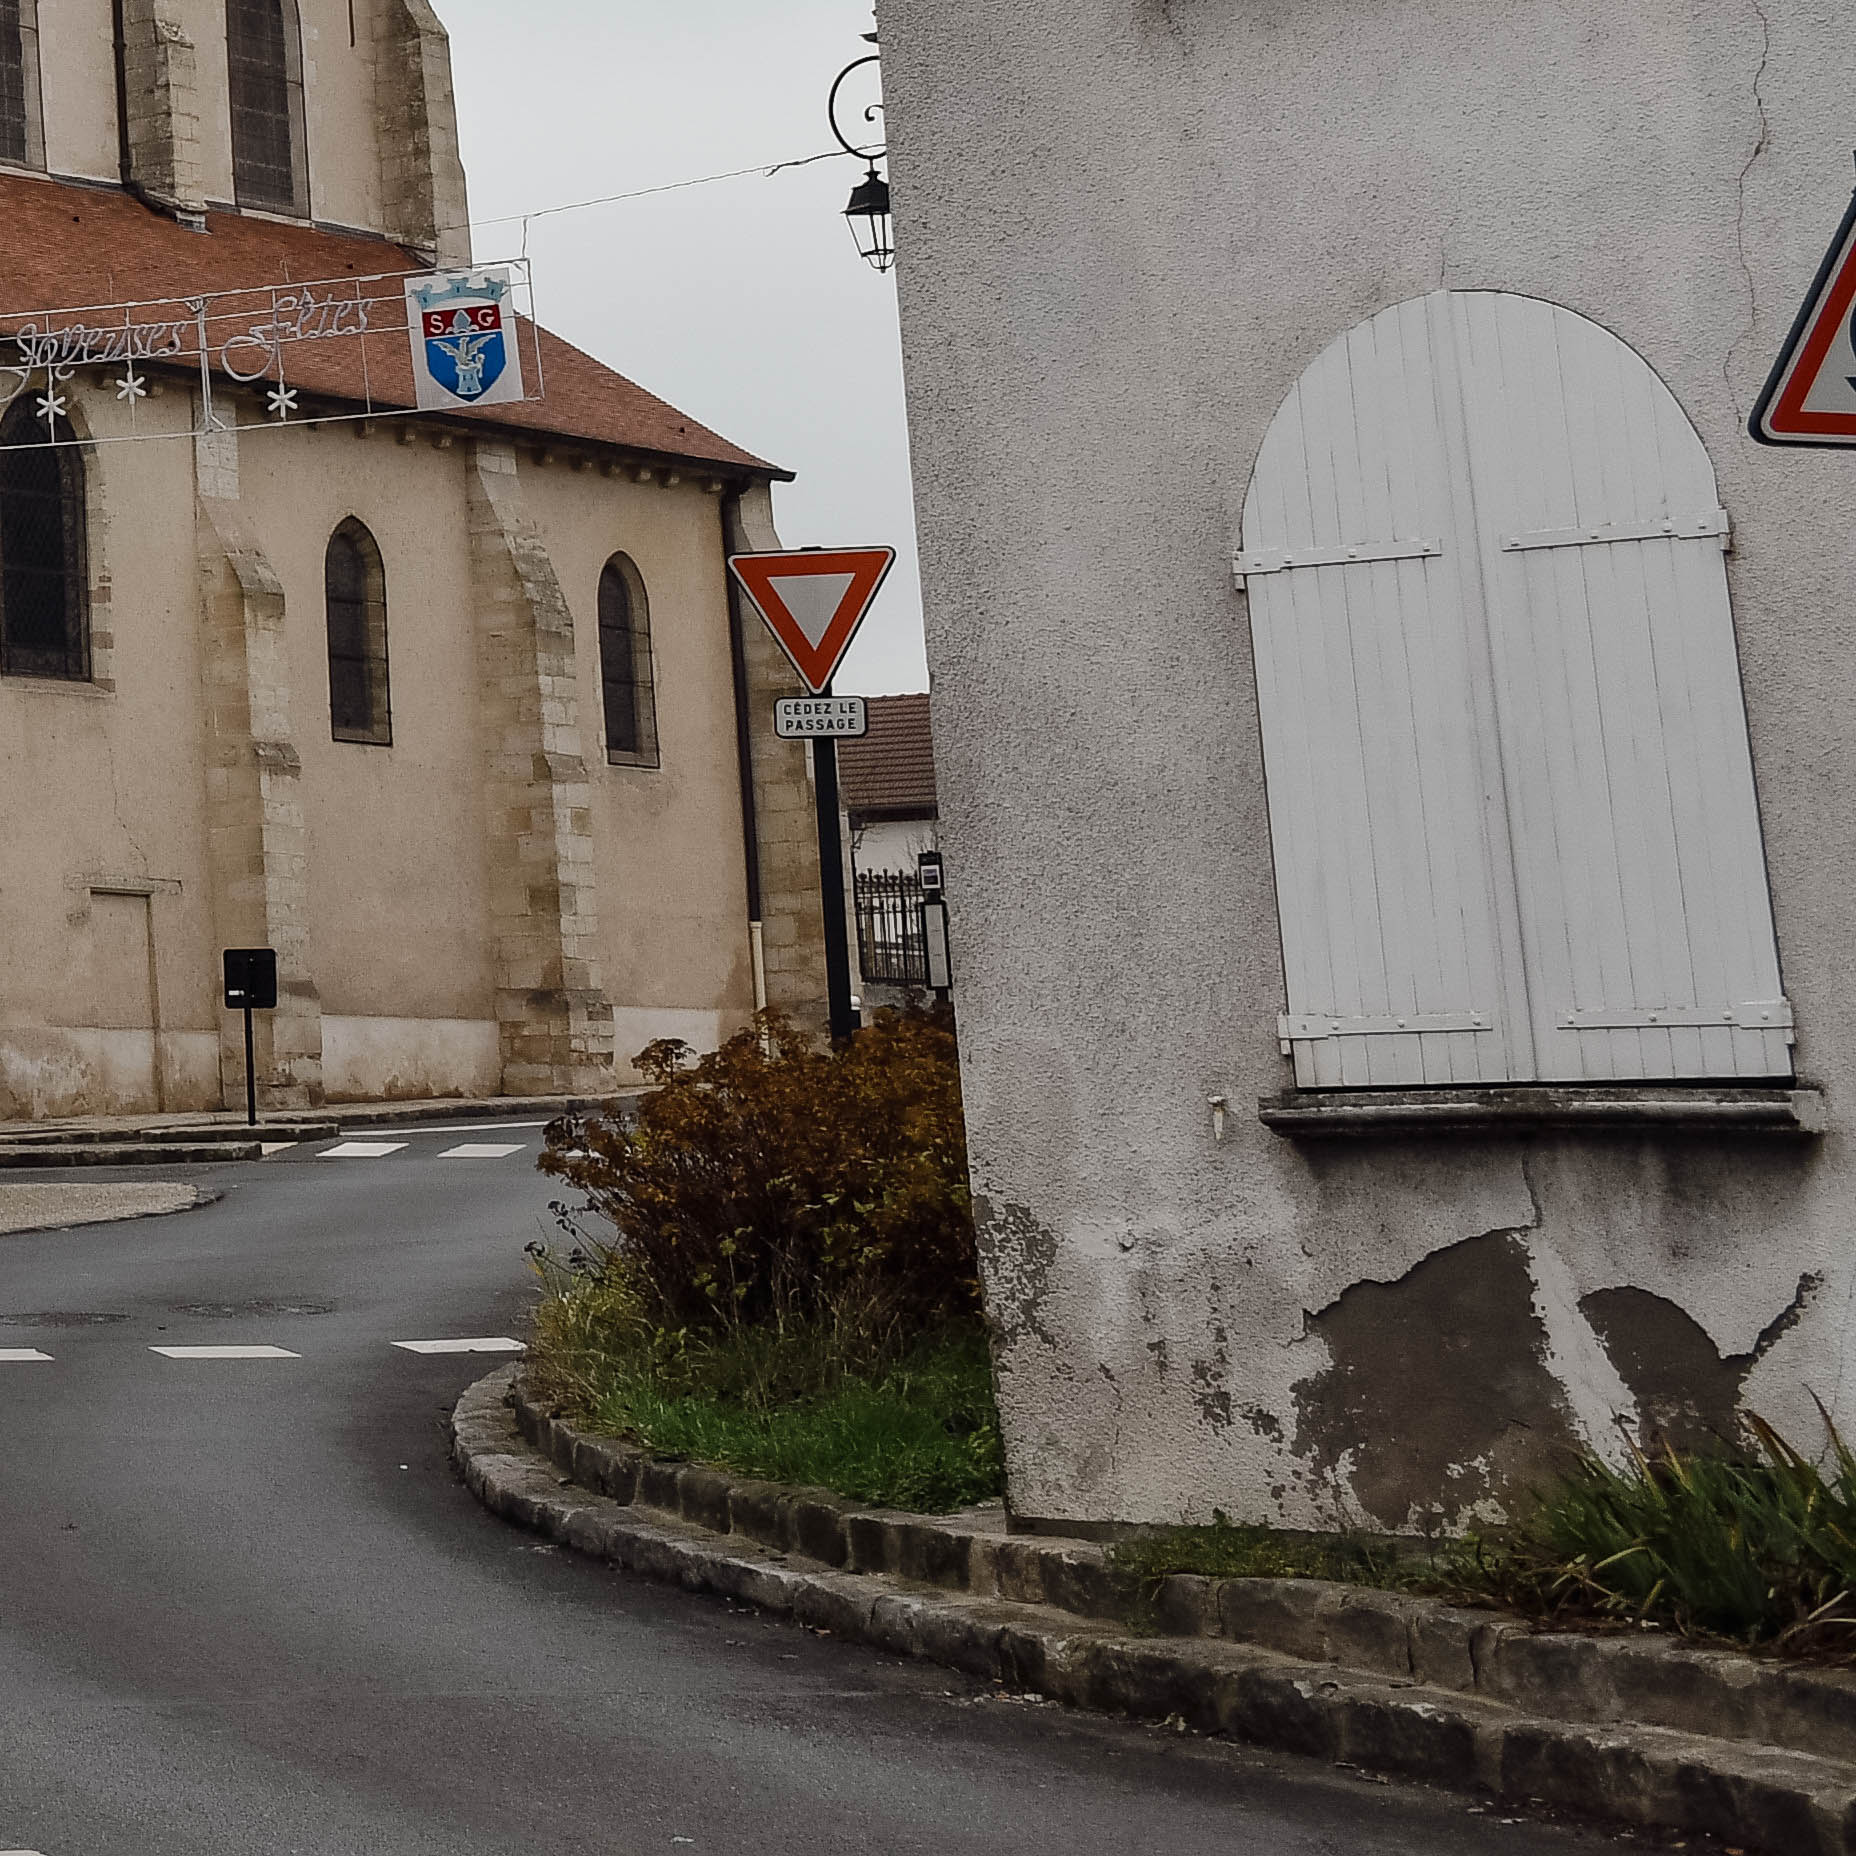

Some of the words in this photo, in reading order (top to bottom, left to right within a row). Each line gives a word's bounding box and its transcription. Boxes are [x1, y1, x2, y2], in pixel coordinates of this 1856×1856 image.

[429, 314, 444, 334] S
[477, 309, 495, 327] G
[839, 702, 857, 715] LE
[785, 718, 857, 732] PASSAGE
